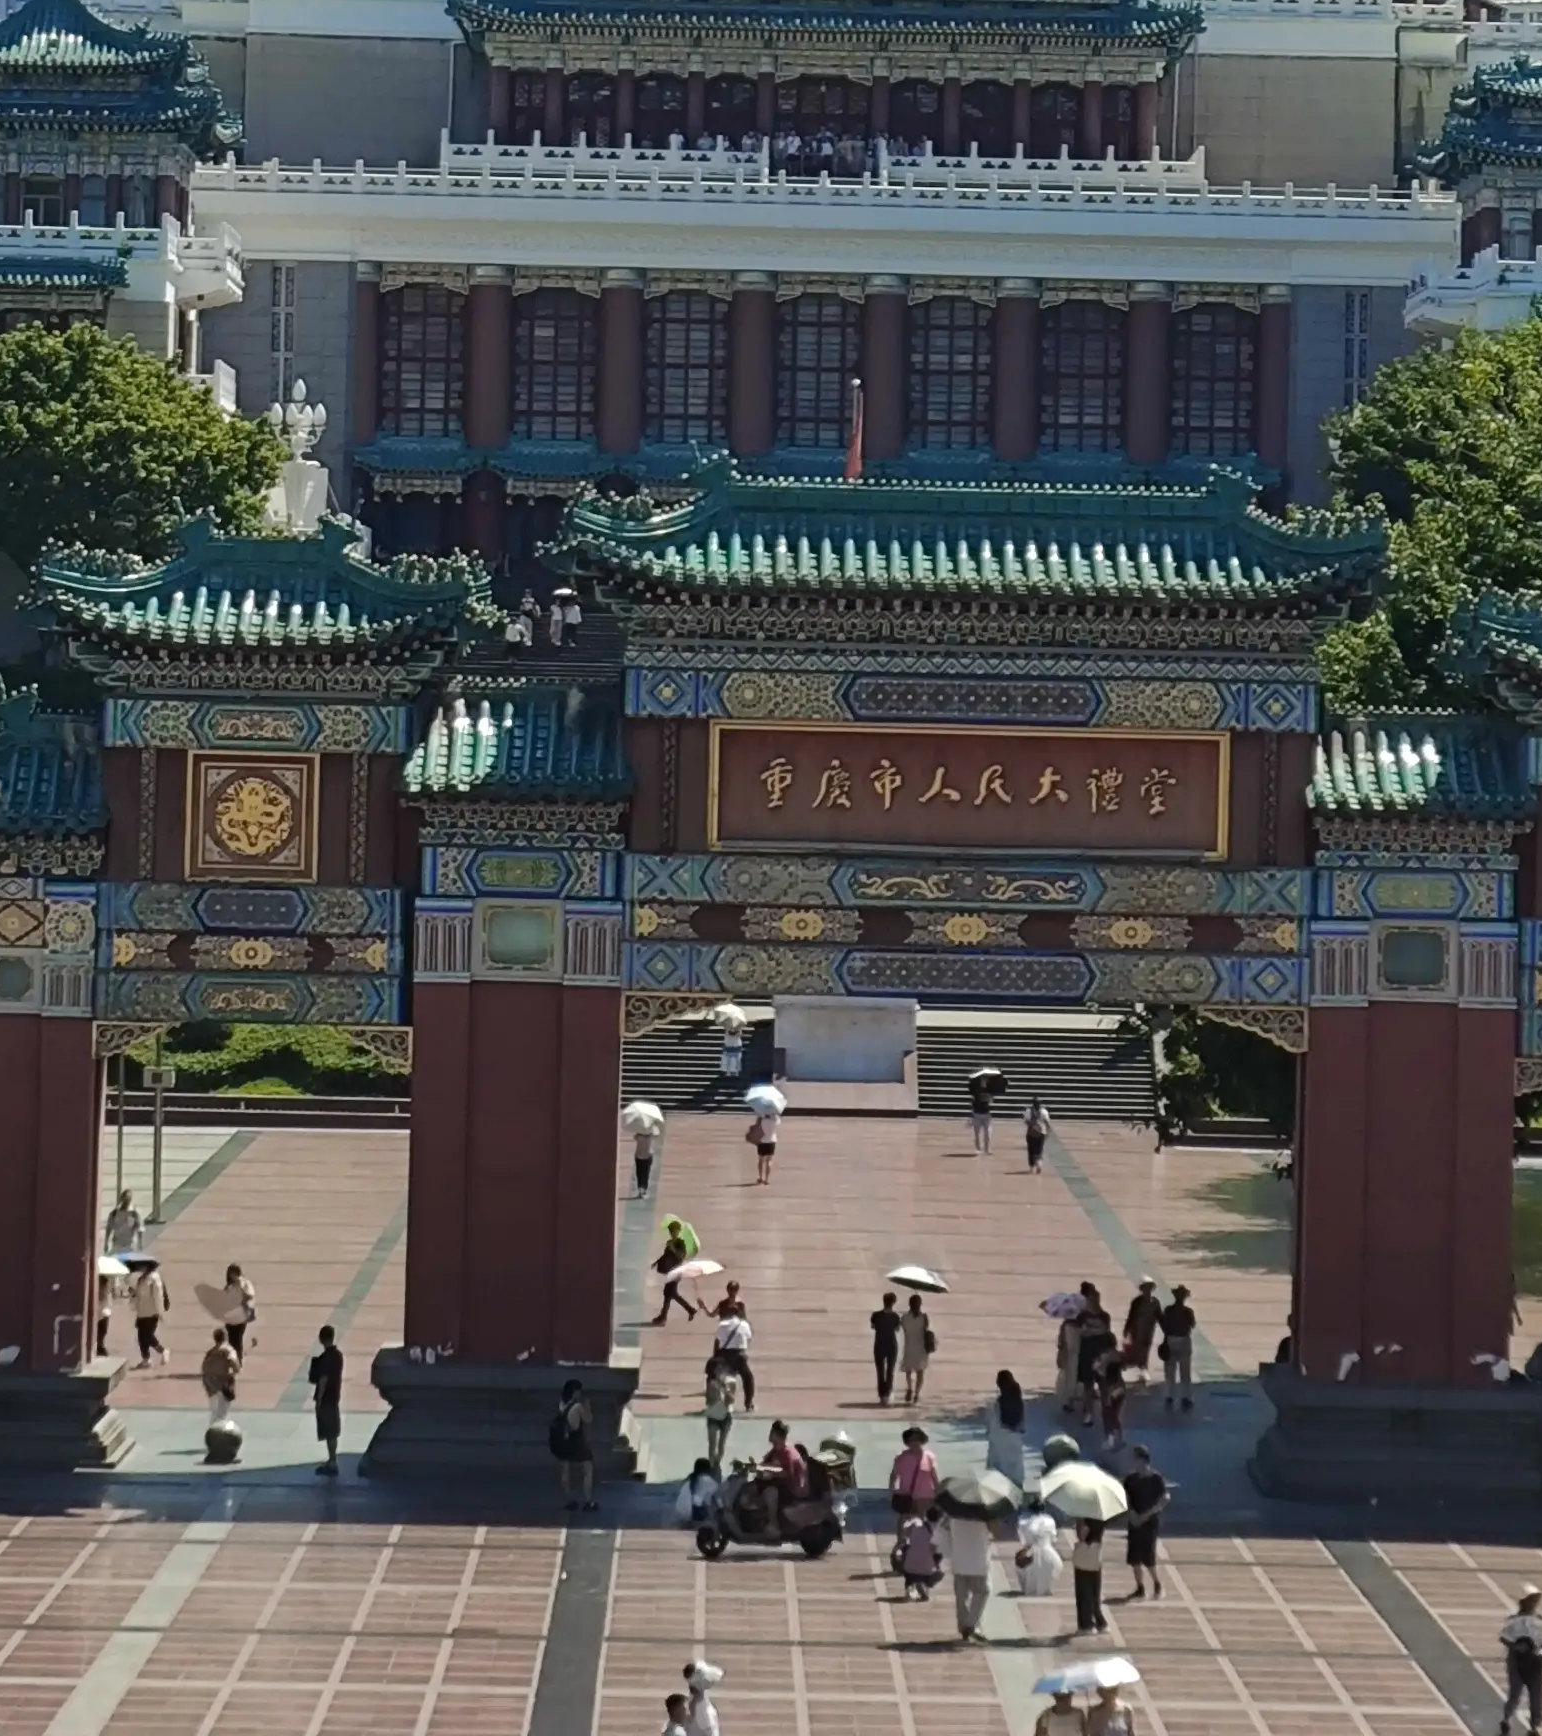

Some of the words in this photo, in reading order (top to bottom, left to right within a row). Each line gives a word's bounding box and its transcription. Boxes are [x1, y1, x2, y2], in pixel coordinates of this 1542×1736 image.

[760, 757, 1178, 815] 重慶市人民大禮堂
